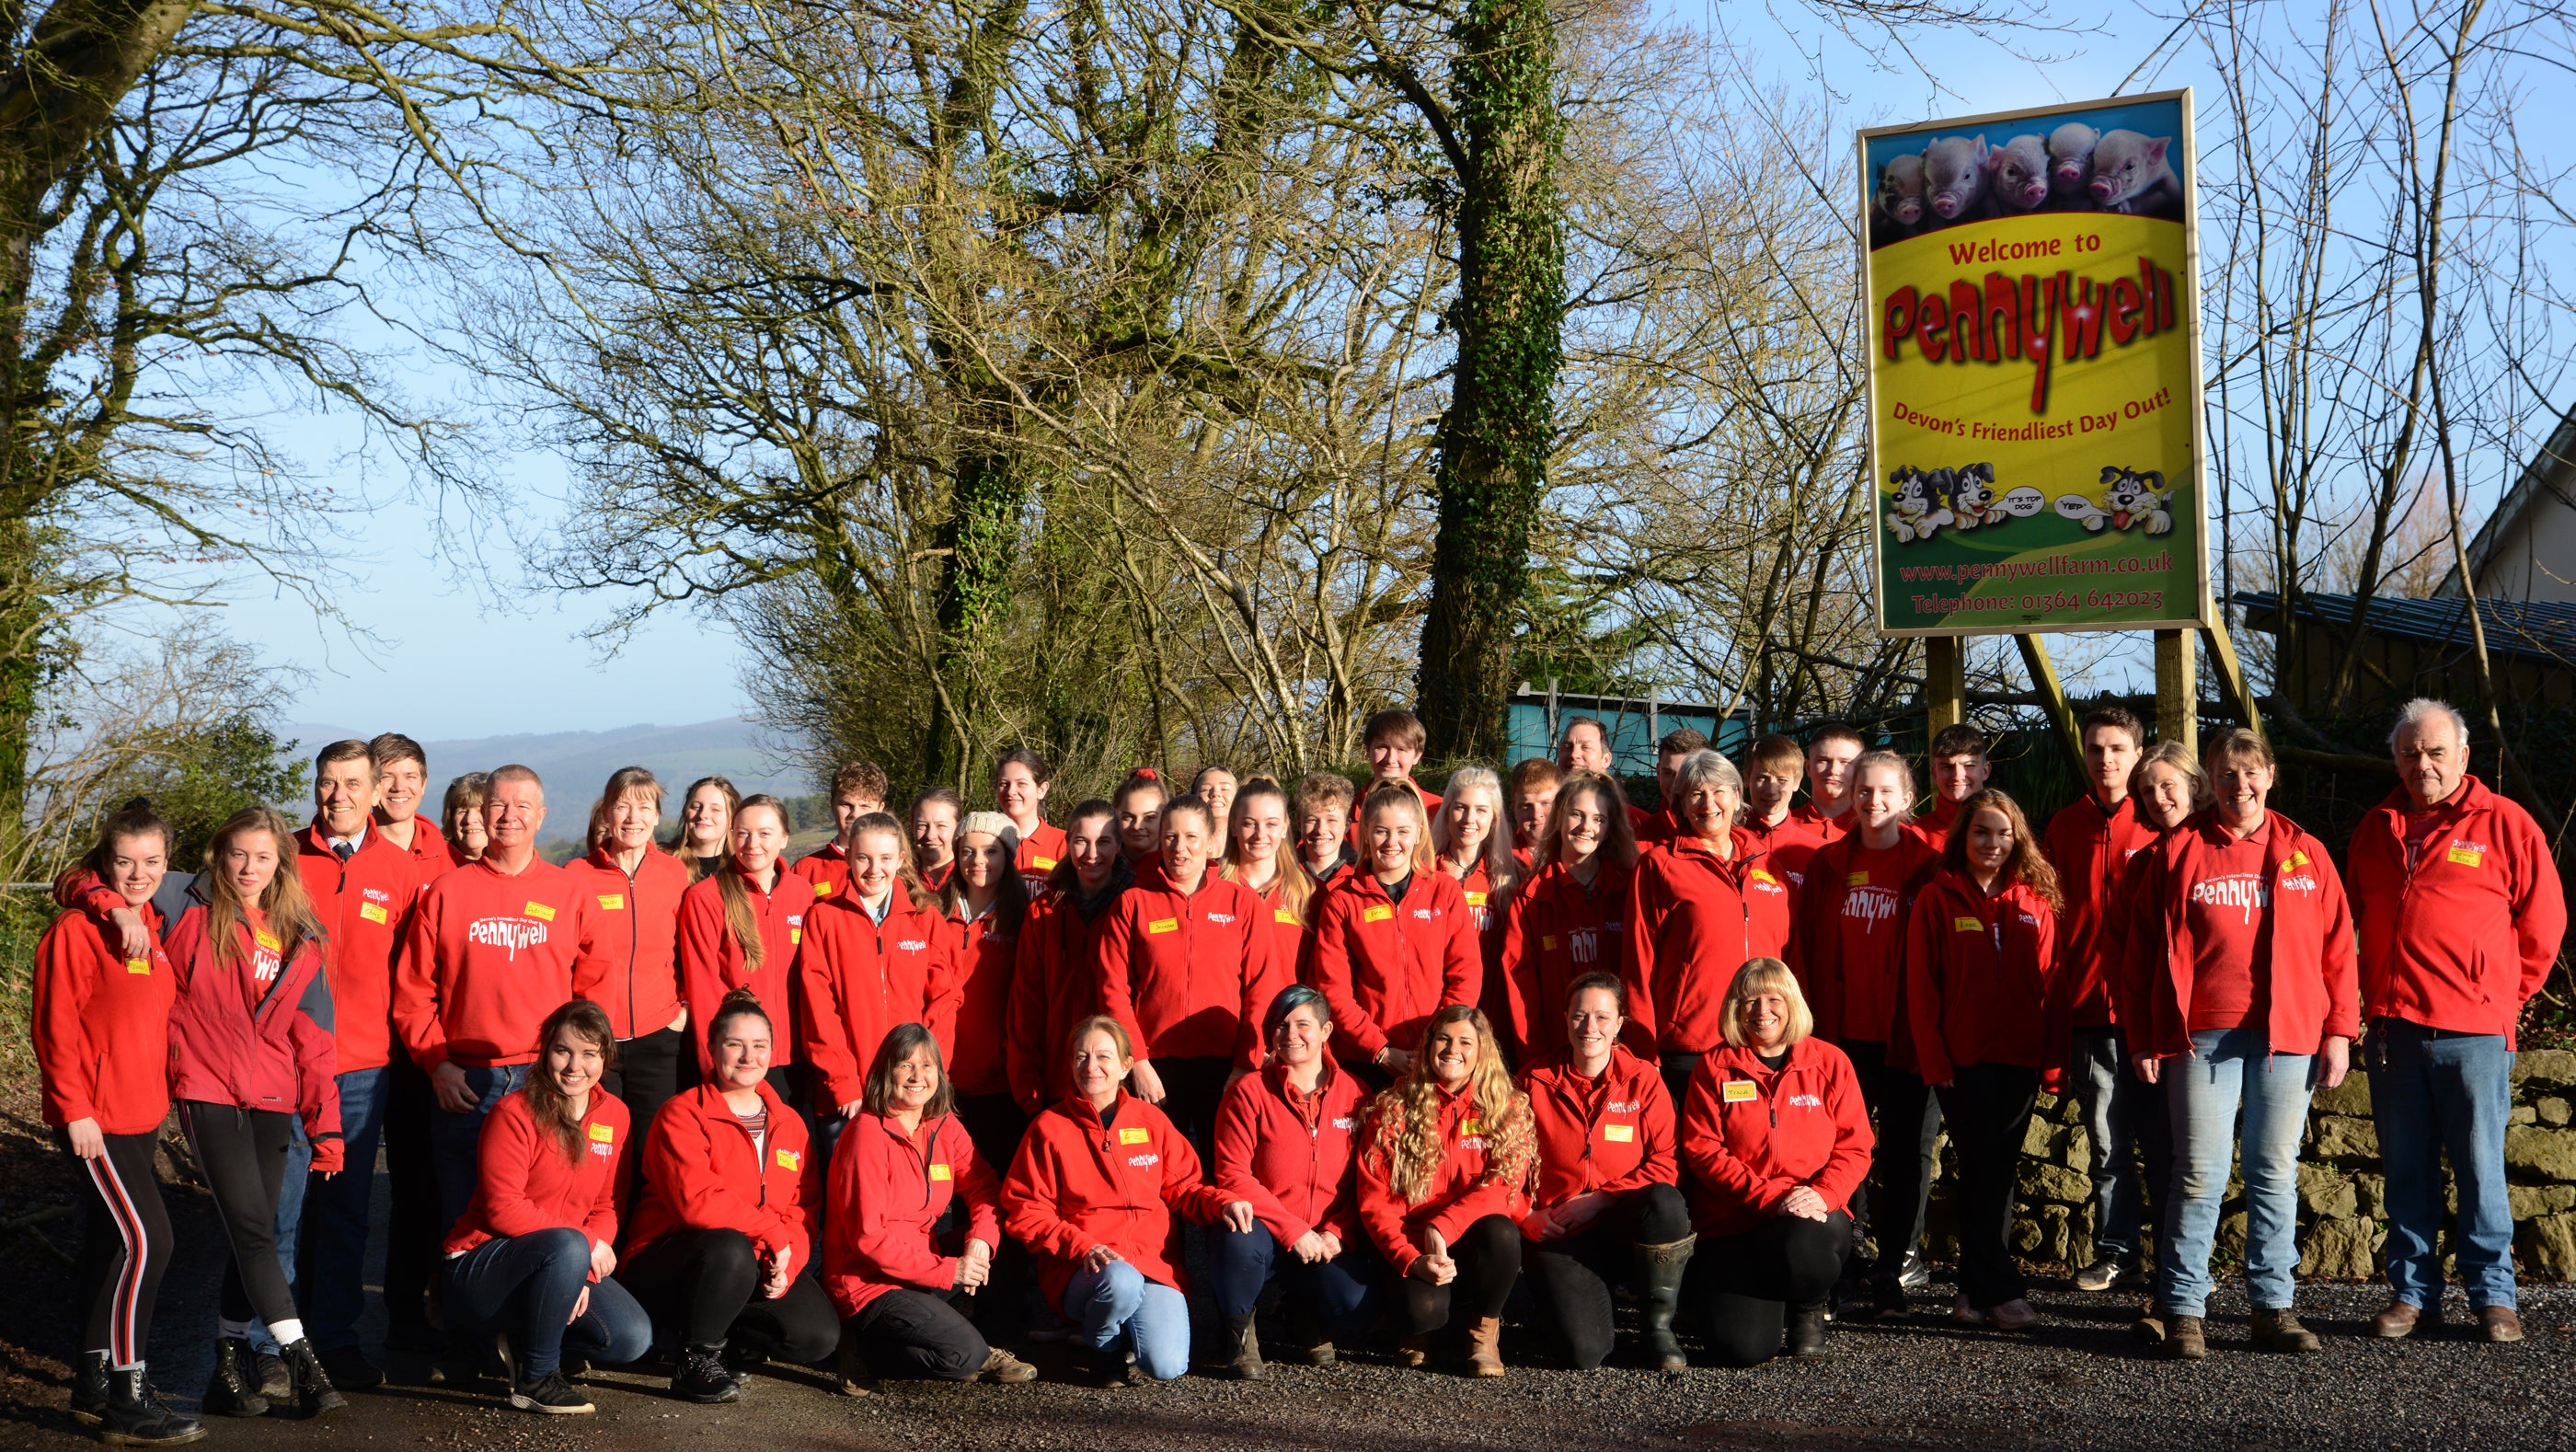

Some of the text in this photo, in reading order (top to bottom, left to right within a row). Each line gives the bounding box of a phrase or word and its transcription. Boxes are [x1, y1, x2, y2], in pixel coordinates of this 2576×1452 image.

[1949, 233, 2101, 266] Welcome to
[1883, 256, 2173, 413] Pennywell
[1893, 386, 2171, 441] Devon's Friendliest Day Out!
[1900, 550, 2173, 585] www.pennywellfarm.co.uk
[1911, 589, 2163, 617] Telephone: 01364 642023
[2193, 879, 2269, 926] Pennyw
[468, 920, 547, 962] Pennywell
